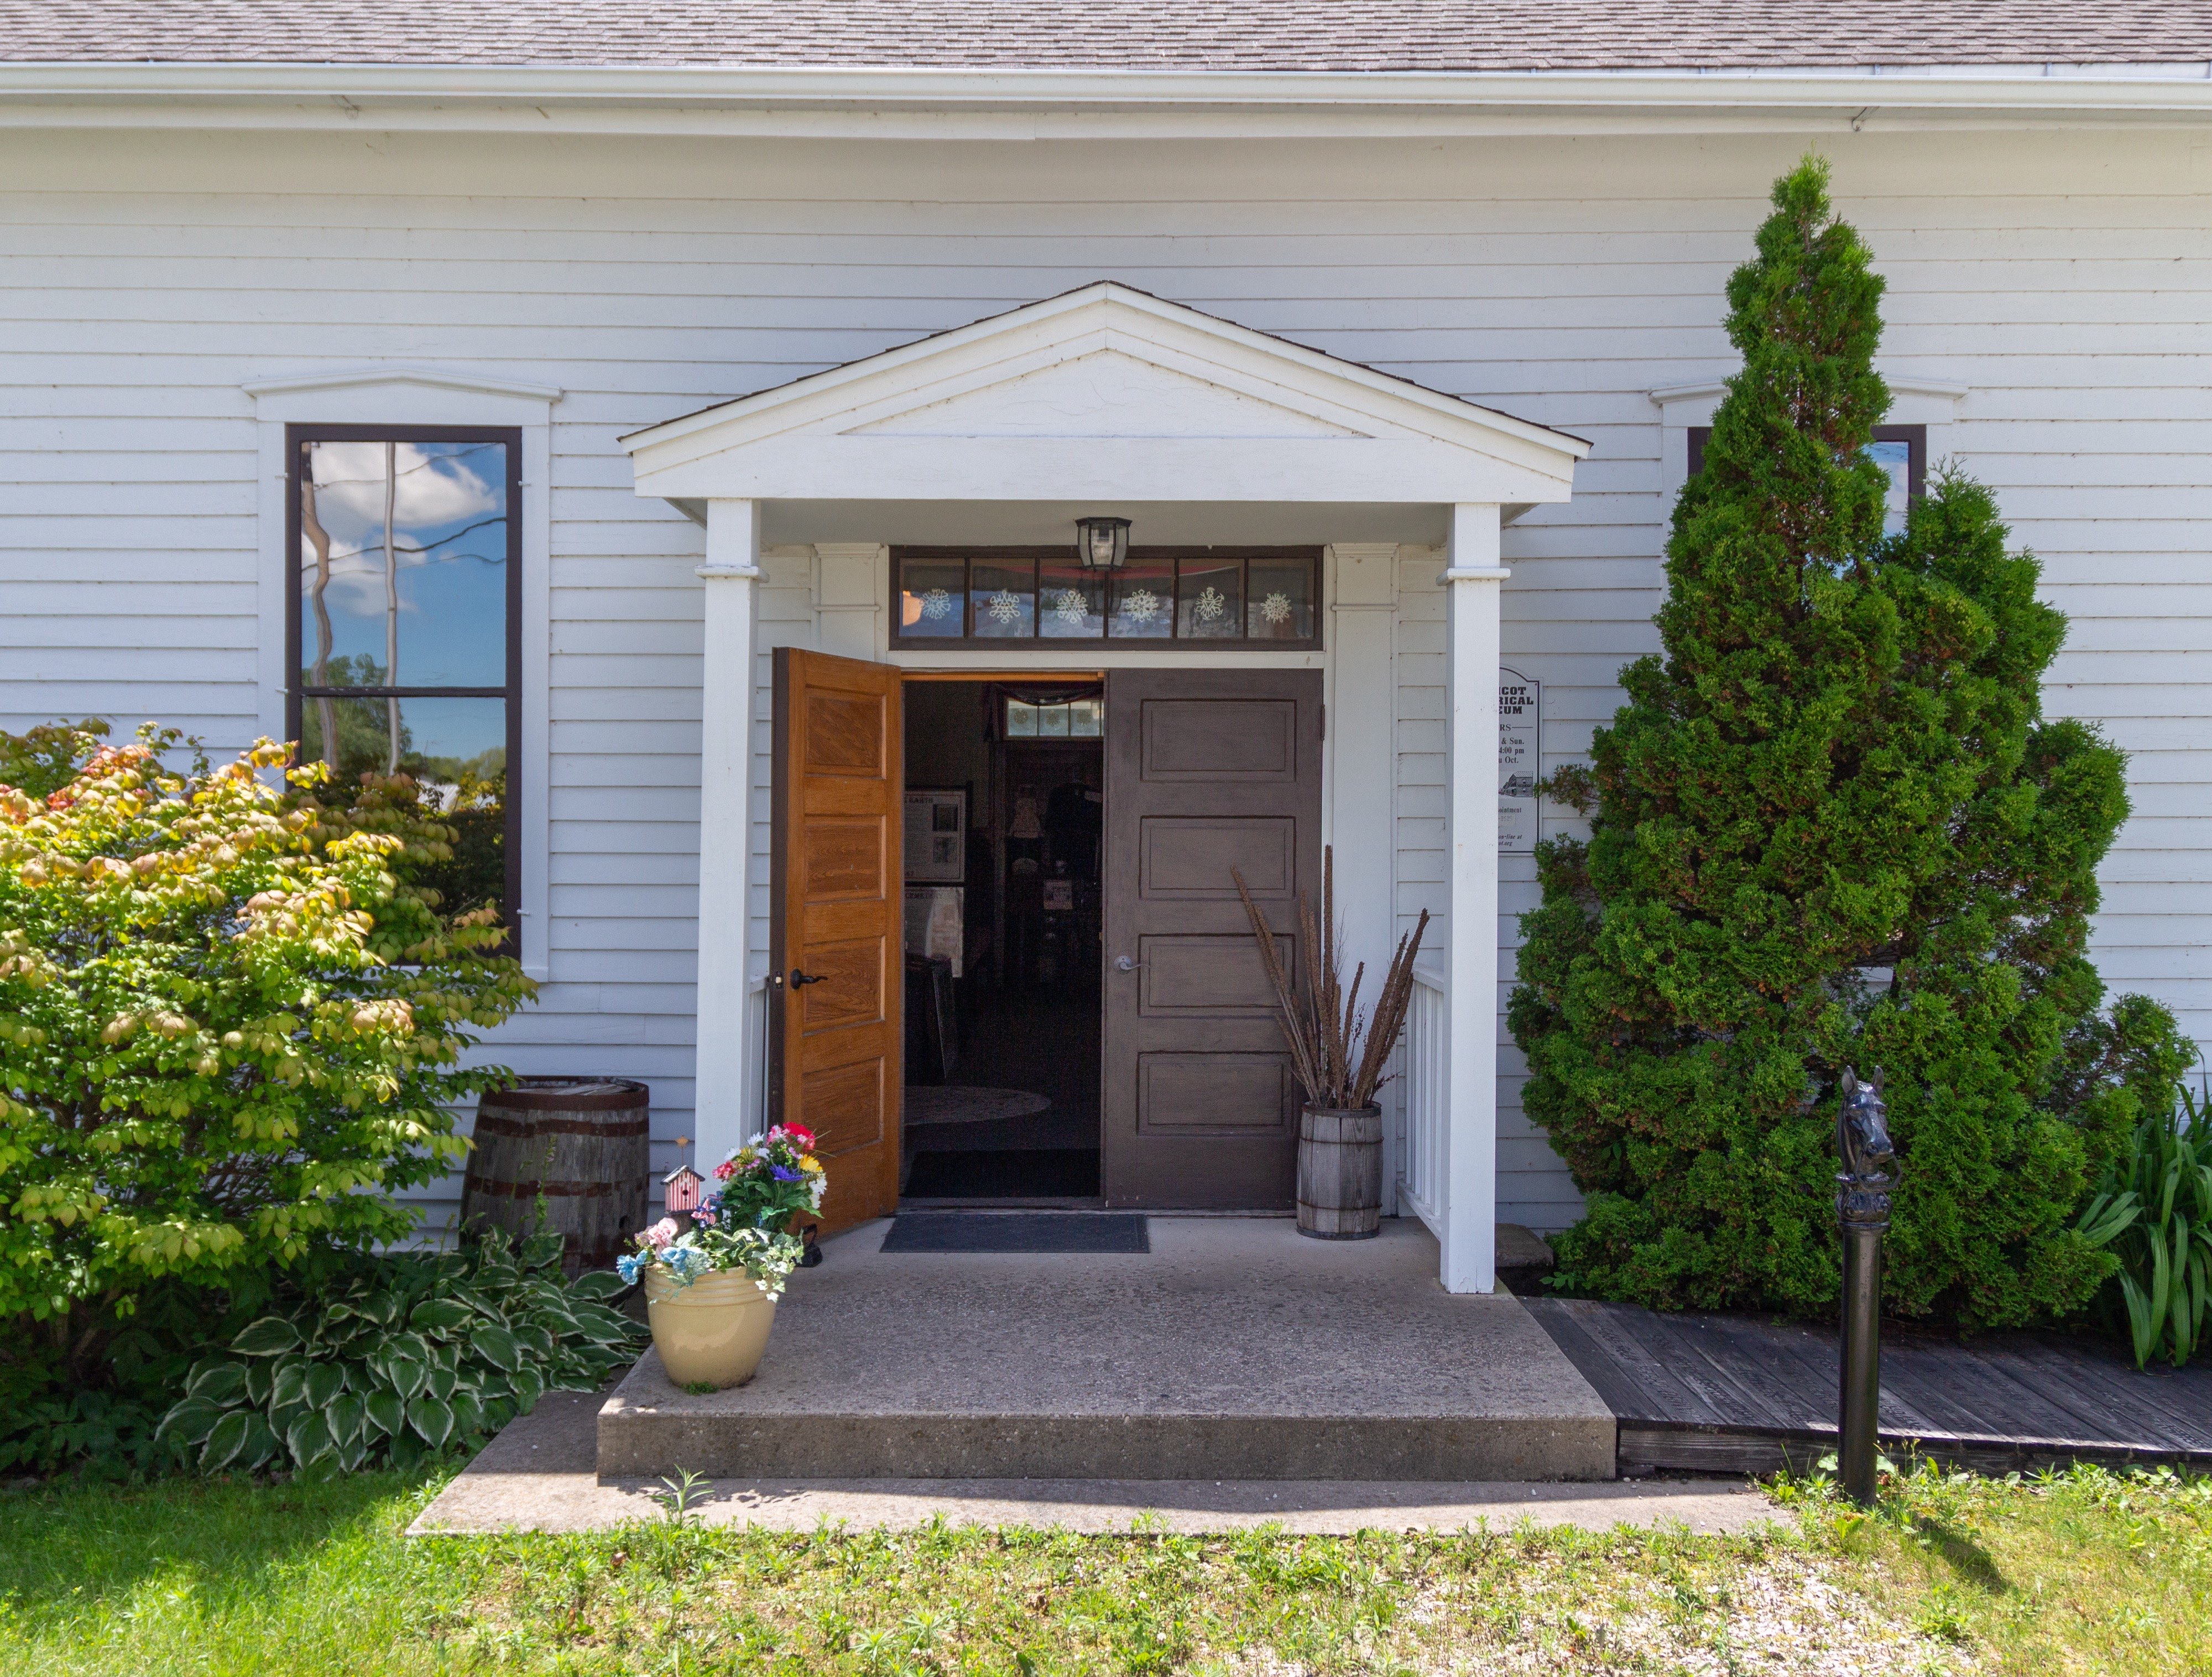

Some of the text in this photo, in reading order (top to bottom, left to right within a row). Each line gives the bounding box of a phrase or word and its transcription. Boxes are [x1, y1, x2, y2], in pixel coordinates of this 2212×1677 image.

[1499, 686, 1526, 695] COT
[1499, 696, 1534, 705] RICAL
[1499, 706, 1522, 714] UM
